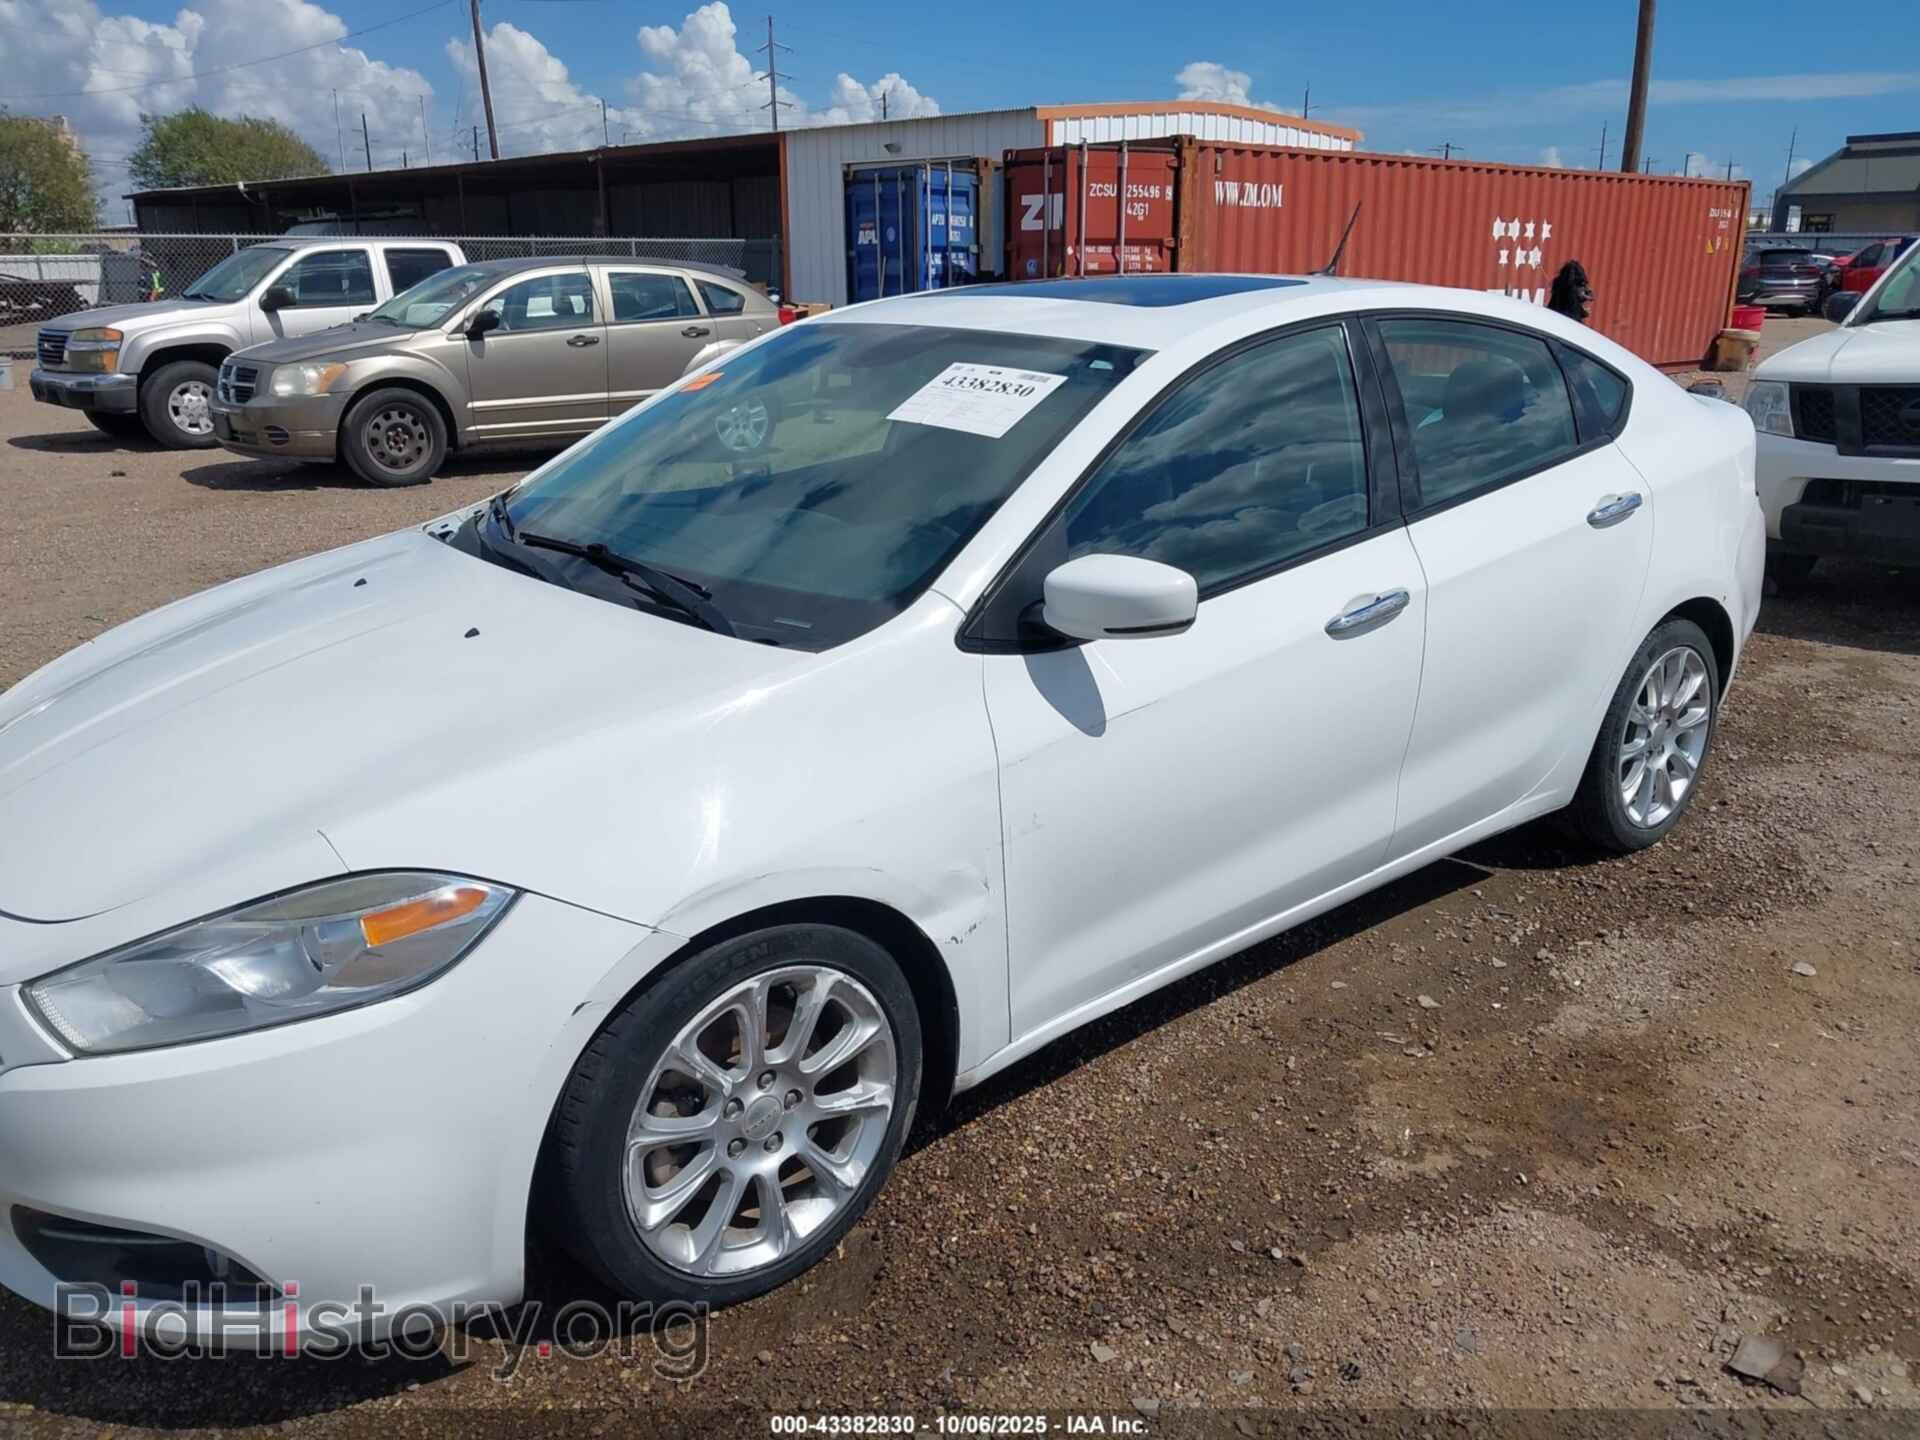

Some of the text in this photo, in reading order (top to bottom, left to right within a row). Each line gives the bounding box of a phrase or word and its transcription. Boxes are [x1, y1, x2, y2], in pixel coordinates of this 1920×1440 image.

[1089, 183, 1117, 197] ZCSU
[1127, 184, 1161, 199] 255496
[1126, 202, 1149, 216] 42G1
[942, 376, 1036, 398] 43382830
